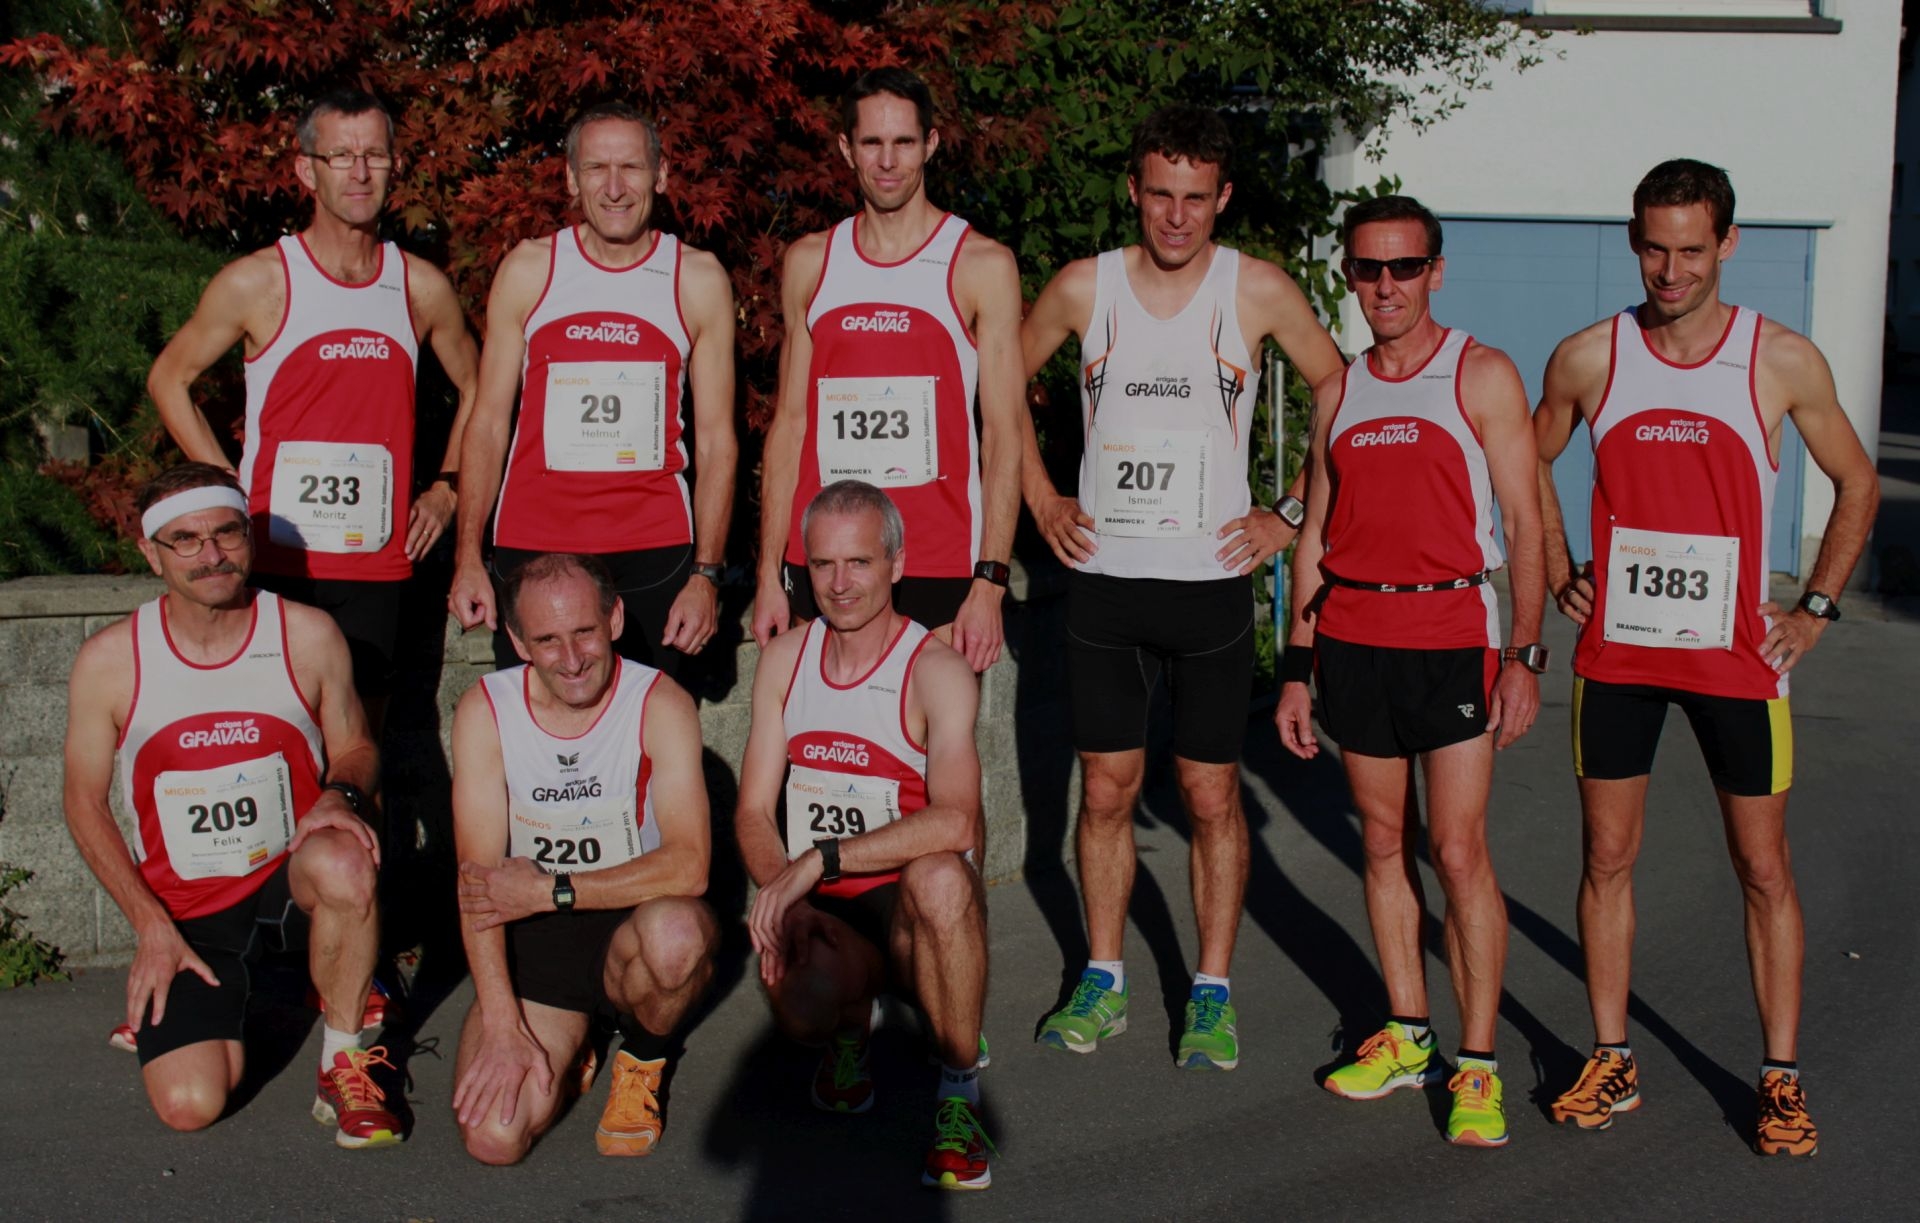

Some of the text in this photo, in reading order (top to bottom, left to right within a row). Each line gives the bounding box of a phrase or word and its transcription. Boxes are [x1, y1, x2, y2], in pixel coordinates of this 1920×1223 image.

[841, 316, 910, 333] GRAVAG
[565, 324, 640, 345] GRAVAG
[319, 344, 390, 360] GRAVAG
[554, 378, 591, 386] MIGROS
[1155, 376, 1178, 384] erdgas
[826, 394, 858, 402] MIGROS
[1125, 383, 1191, 398] GRAVAG
[581, 394, 621, 424] 29
[832, 409, 910, 440] 1323
[1382, 423, 1406, 431] erdgas
[1670, 419, 1695, 427] erdgas
[582, 430, 620, 439] Helmut
[1351, 428, 1420, 448] GRAVAG
[1635, 425, 1710, 445] GRAVAG
[1103, 444, 1136, 452] MIGROS
[283, 457, 320, 465] MIGROS
[1117, 461, 1176, 491] 207
[299, 475, 360, 506] 233
[1128, 496, 1162, 505] Ismael
[312, 510, 347, 520] Moritz
[1619, 545, 1656, 557] MIGROS
[1724, 552, 1732, 568] 2015
[1626, 563, 1709, 601] 1383
[214, 720, 242, 730] erdgas
[179, 727, 260, 749] GRAVAG
[832, 740, 856, 749] erdgas
[803, 744, 869, 767] GRAVAG
[164, 787, 207, 796] MIGROS
[532, 783, 602, 802] GRAVAG
[792, 783, 824, 796] MIGROS
[188, 796, 258, 834] 209
[515, 813, 552, 830] MIGROS
[621, 811, 631, 827] 2015
[808, 803, 866, 836] 239
[213, 836, 242, 848] Felix
[534, 836, 601, 865] 220
